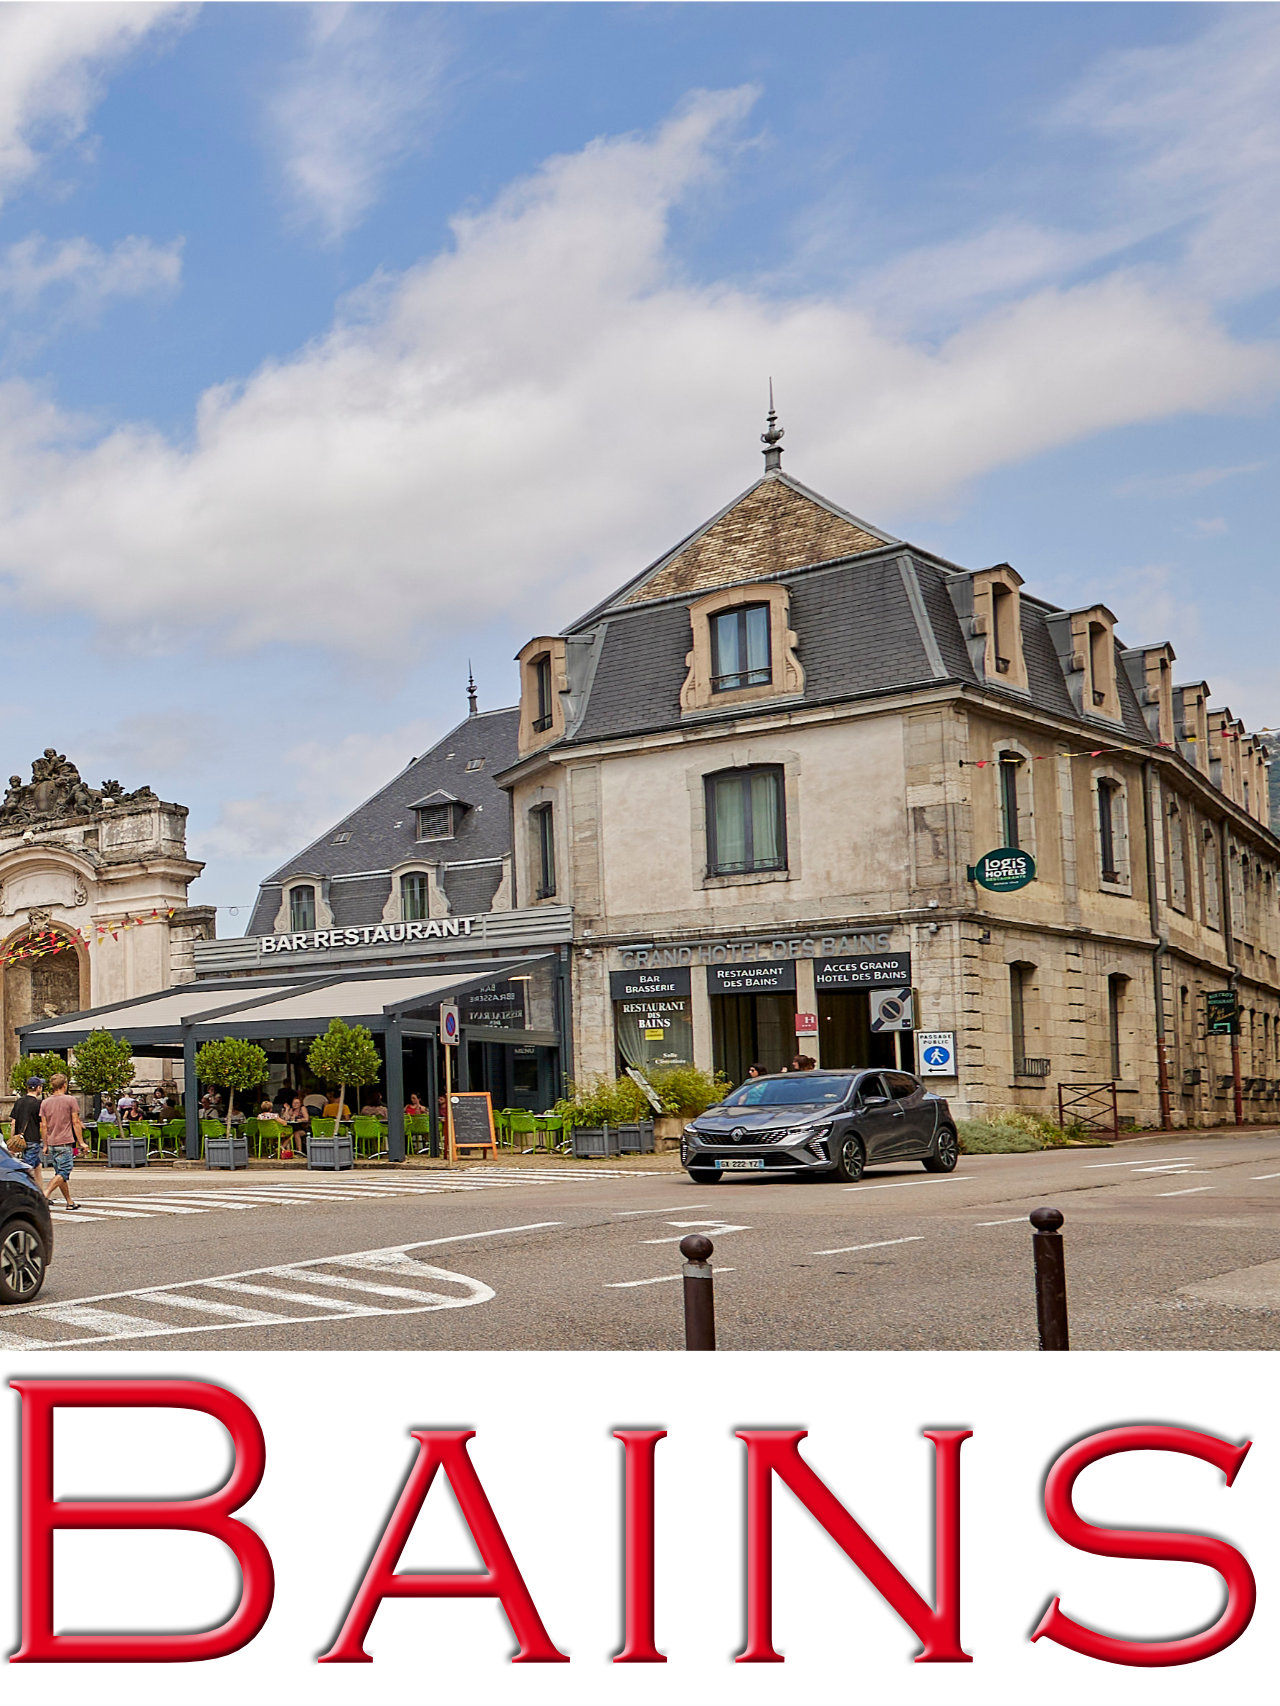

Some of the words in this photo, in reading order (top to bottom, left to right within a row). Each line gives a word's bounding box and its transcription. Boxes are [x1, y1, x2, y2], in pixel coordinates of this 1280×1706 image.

[985, 868, 1027, 878] HOTELS
[261, 933, 308, 953] BAR
[313, 917, 476, 949] RESTAURANT
[621, 947, 690, 969] GRAND
[698, 943, 768, 965] HOTEL
[772, 939, 815, 960] DES
[822, 933, 892, 956] BAINS
[717, 967, 784, 978] RESTAURANT
[823, 962, 858, 973] ACCES
[860, 961, 899, 971] GRAND
[745, 976, 778, 988] BAINS
[817, 973, 850, 983] HOTEL
[874, 969, 907, 980] BAINS
[625, 983, 676, 994] BRASSERIE
[623, 1001, 686, 1013] RESTAURANT
[638, 1018, 671, 1029] BAINS
[804, 1016, 815, 1024] H
